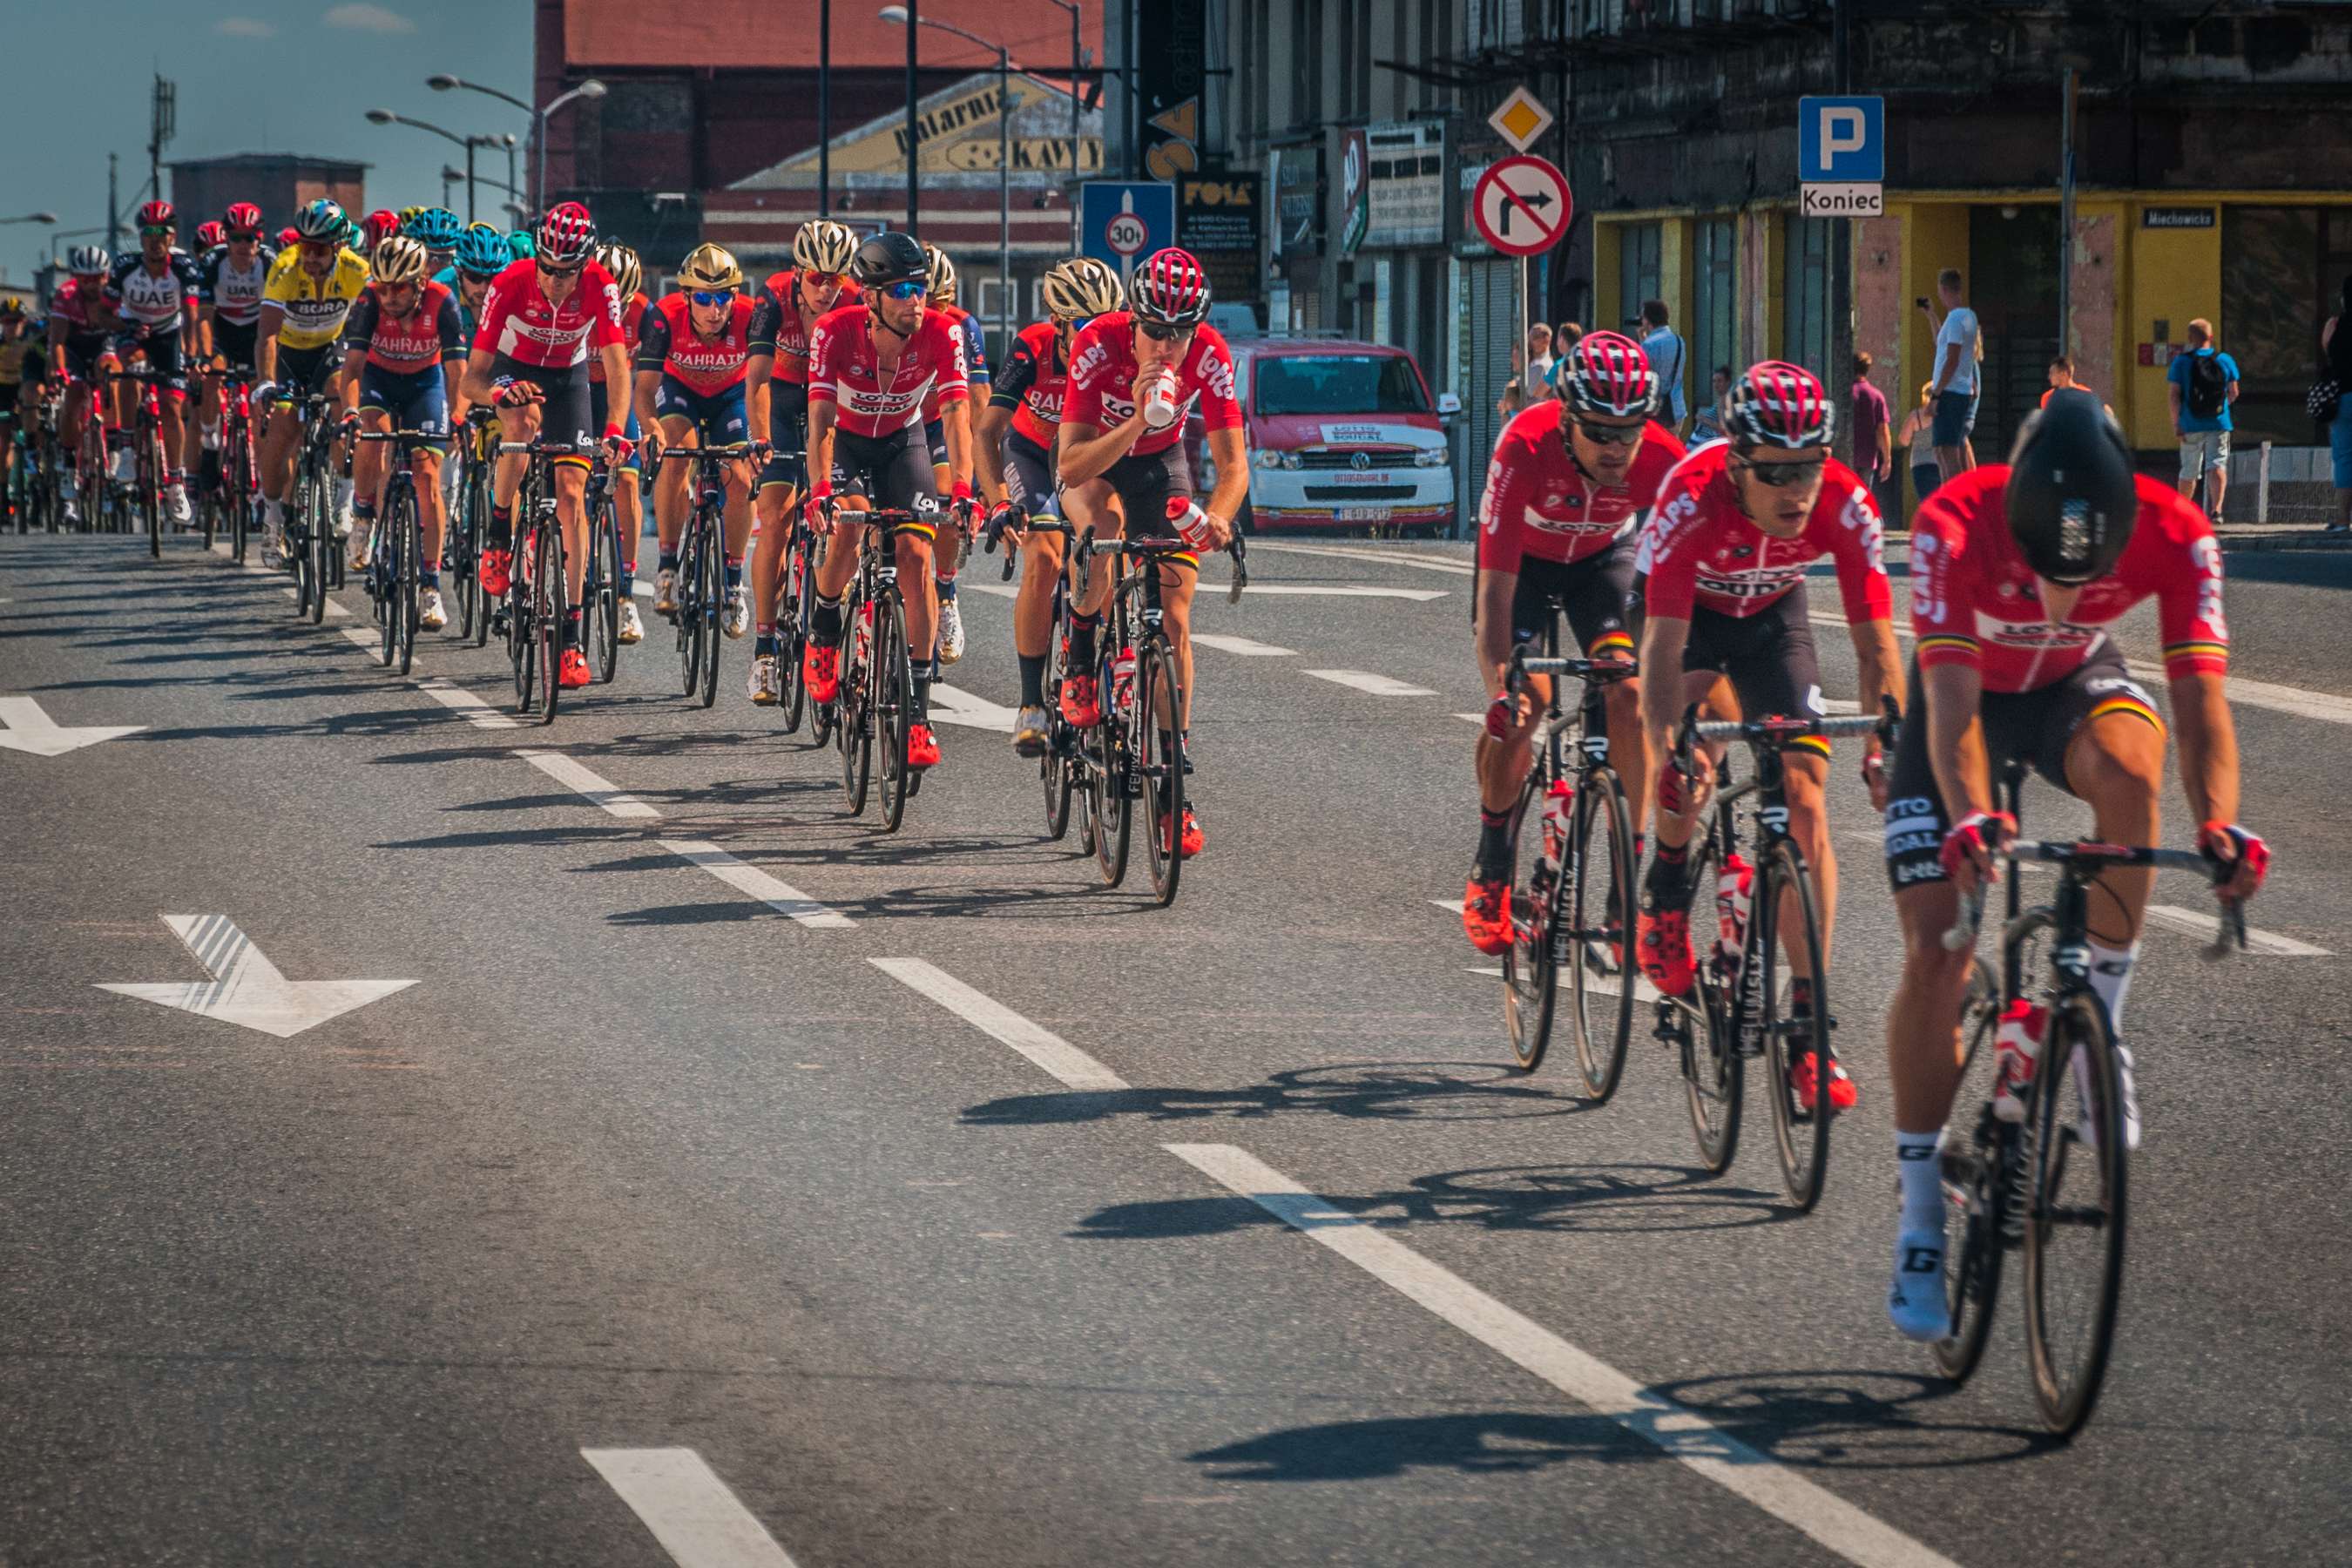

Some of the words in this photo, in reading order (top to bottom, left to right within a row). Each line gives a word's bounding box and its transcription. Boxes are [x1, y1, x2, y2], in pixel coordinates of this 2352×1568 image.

[1820, 106, 1865, 171] P
[1803, 188, 1880, 210] Koniec
[2148, 211, 2212, 226] Miechowicka
[1112, 225, 1141, 245] 30t
[129, 288, 176, 305] UAE
[226, 285, 259, 295] UAE
[299, 301, 346, 314] BORA
[370, 331, 442, 354] BAHRAIN
[672, 350, 747, 366] BAHRAIN
[855, 392, 911, 402] LOTTO
[849, 402, 910, 414] SOUDAL
[1911, 532, 1938, 615] CAPS
[1903, 1247, 1942, 1274] G
